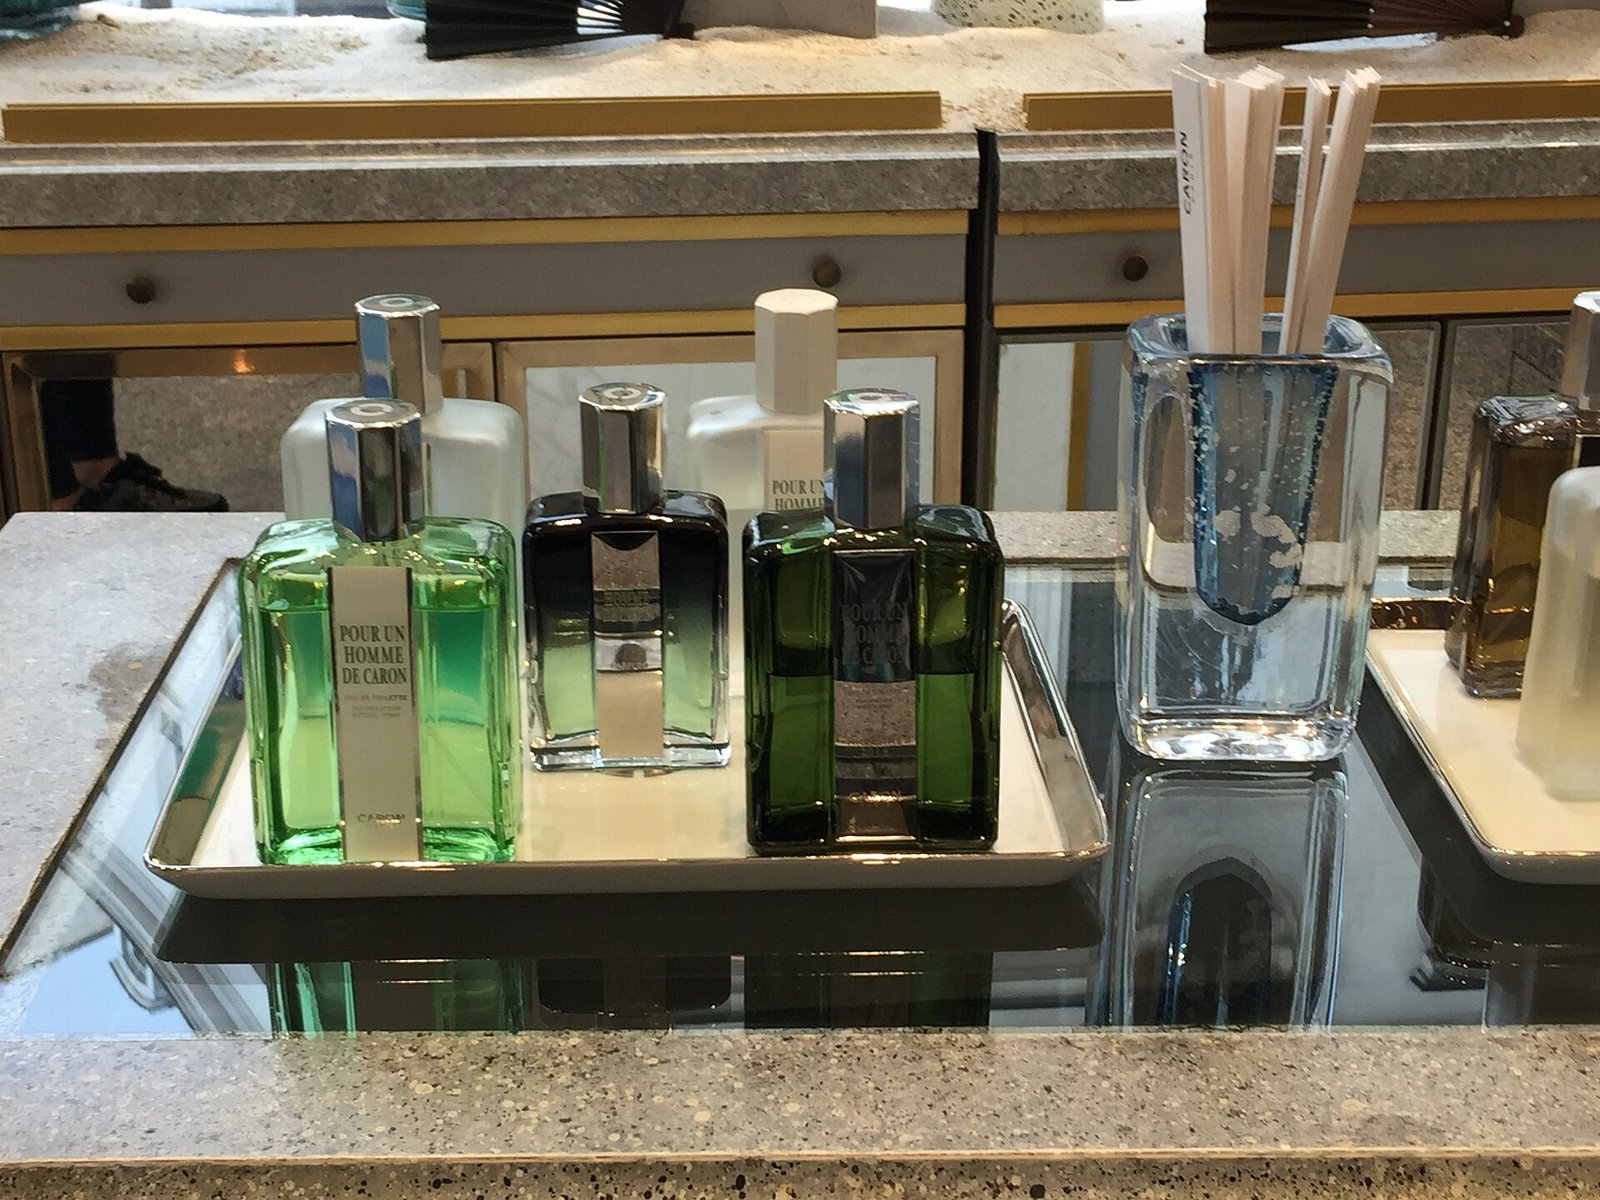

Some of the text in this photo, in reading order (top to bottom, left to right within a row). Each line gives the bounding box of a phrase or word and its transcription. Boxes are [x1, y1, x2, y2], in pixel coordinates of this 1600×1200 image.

[1179, 130, 1191, 215] CARON
[772, 479, 807, 495] POUR
[339, 625, 405, 642] POUR UN
[343, 646, 404, 664] HOMME
[341, 667, 407, 684] DE CARON
